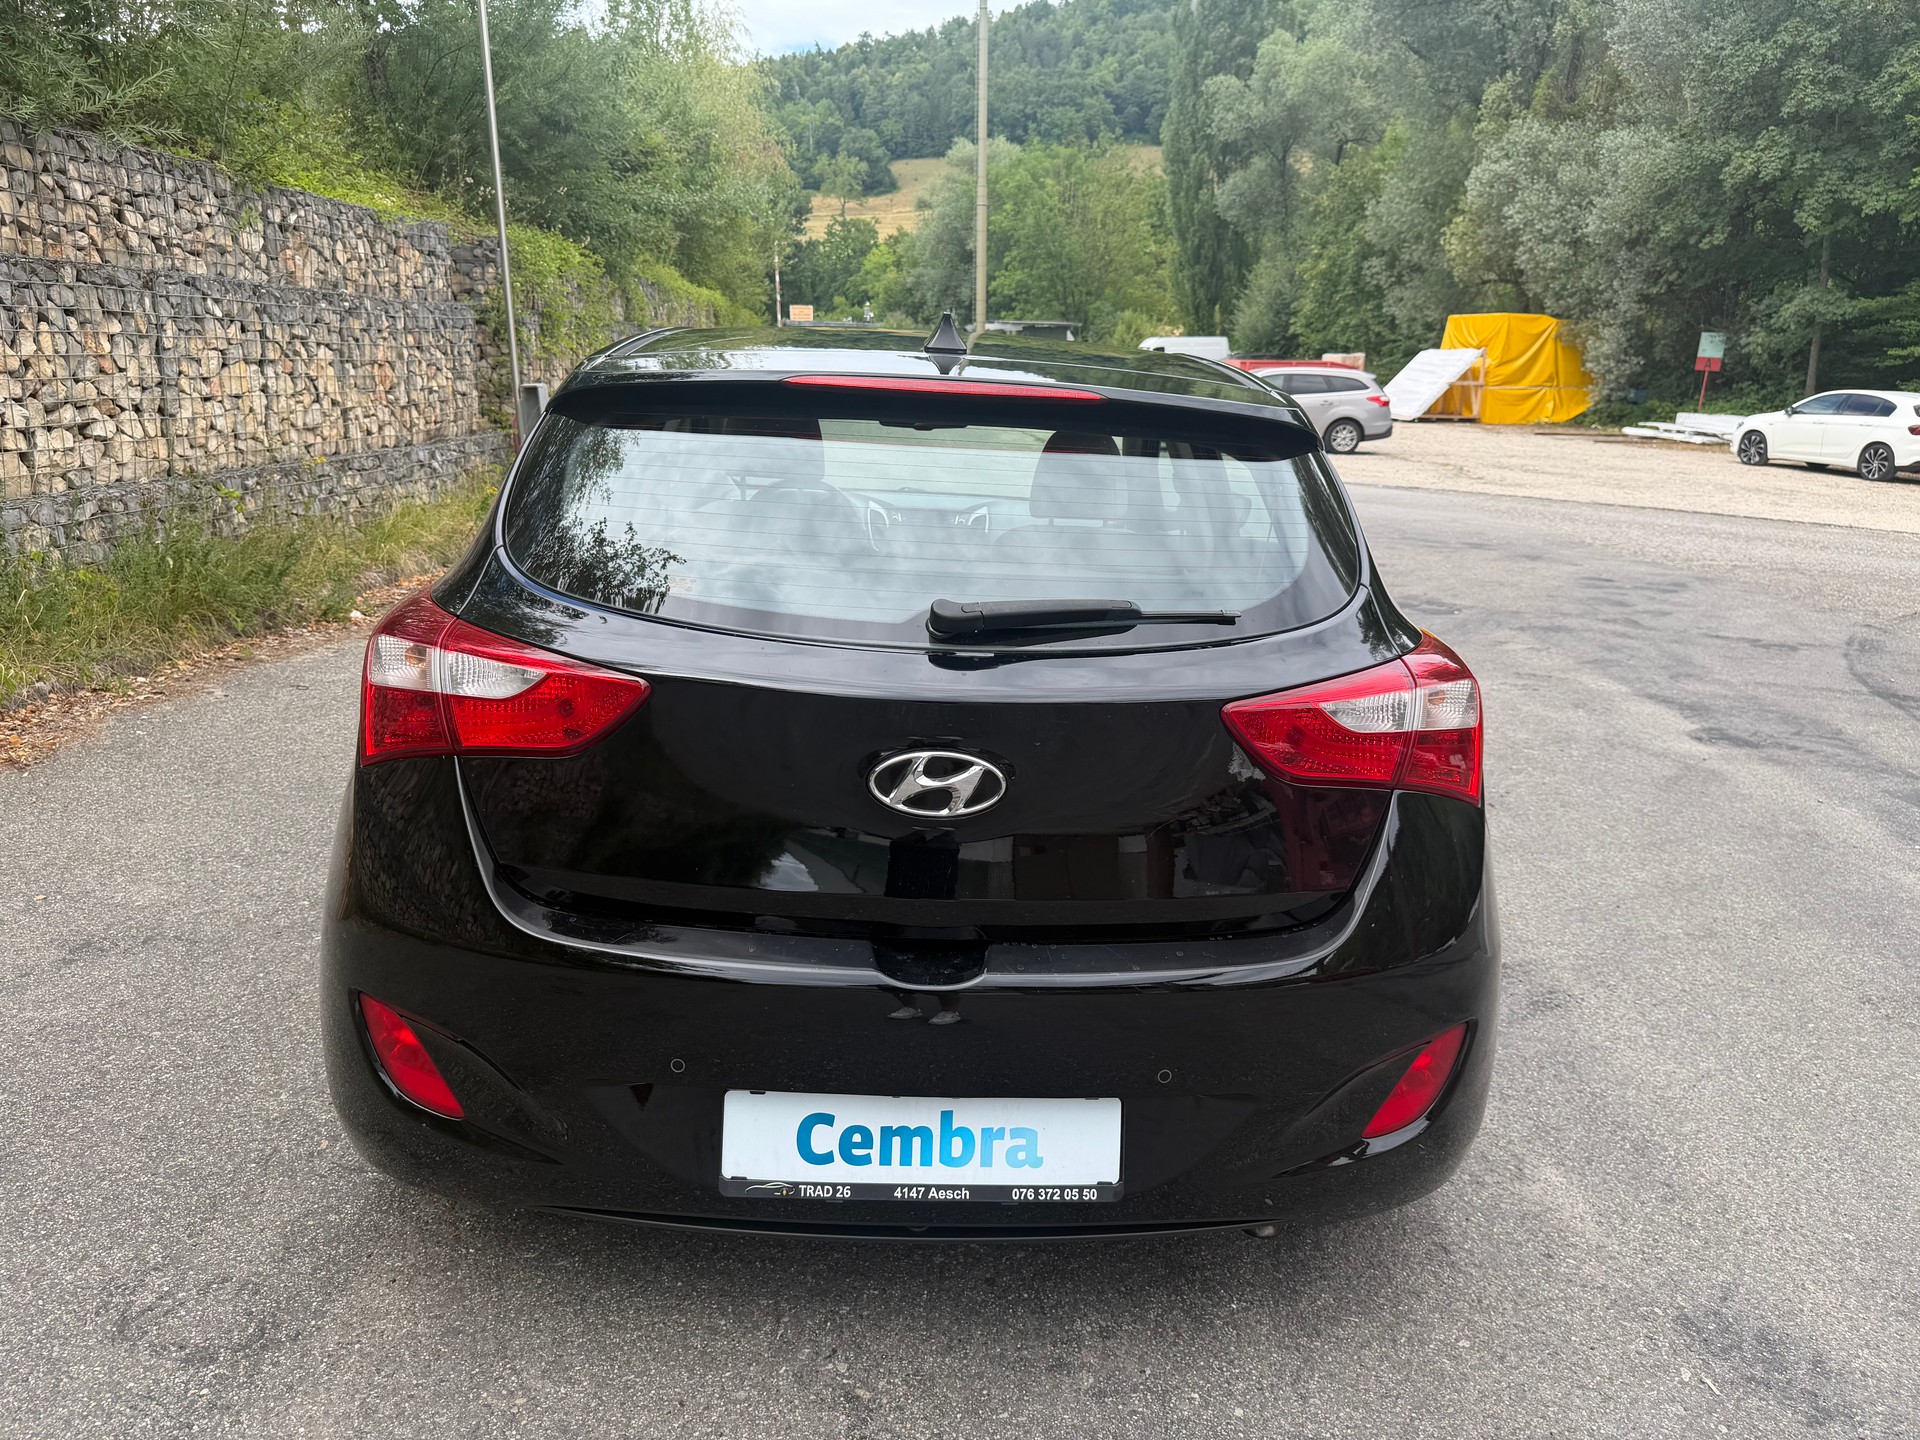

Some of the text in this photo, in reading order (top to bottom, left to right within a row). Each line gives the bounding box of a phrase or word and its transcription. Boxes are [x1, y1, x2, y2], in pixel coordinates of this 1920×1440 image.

[796, 1110, 1043, 1169] Cembra
[799, 1185, 851, 1198] TRAD 26
[894, 1187, 969, 1200] 4147 Aesch
[1012, 1188, 1097, 1200] 076 372 05 50
